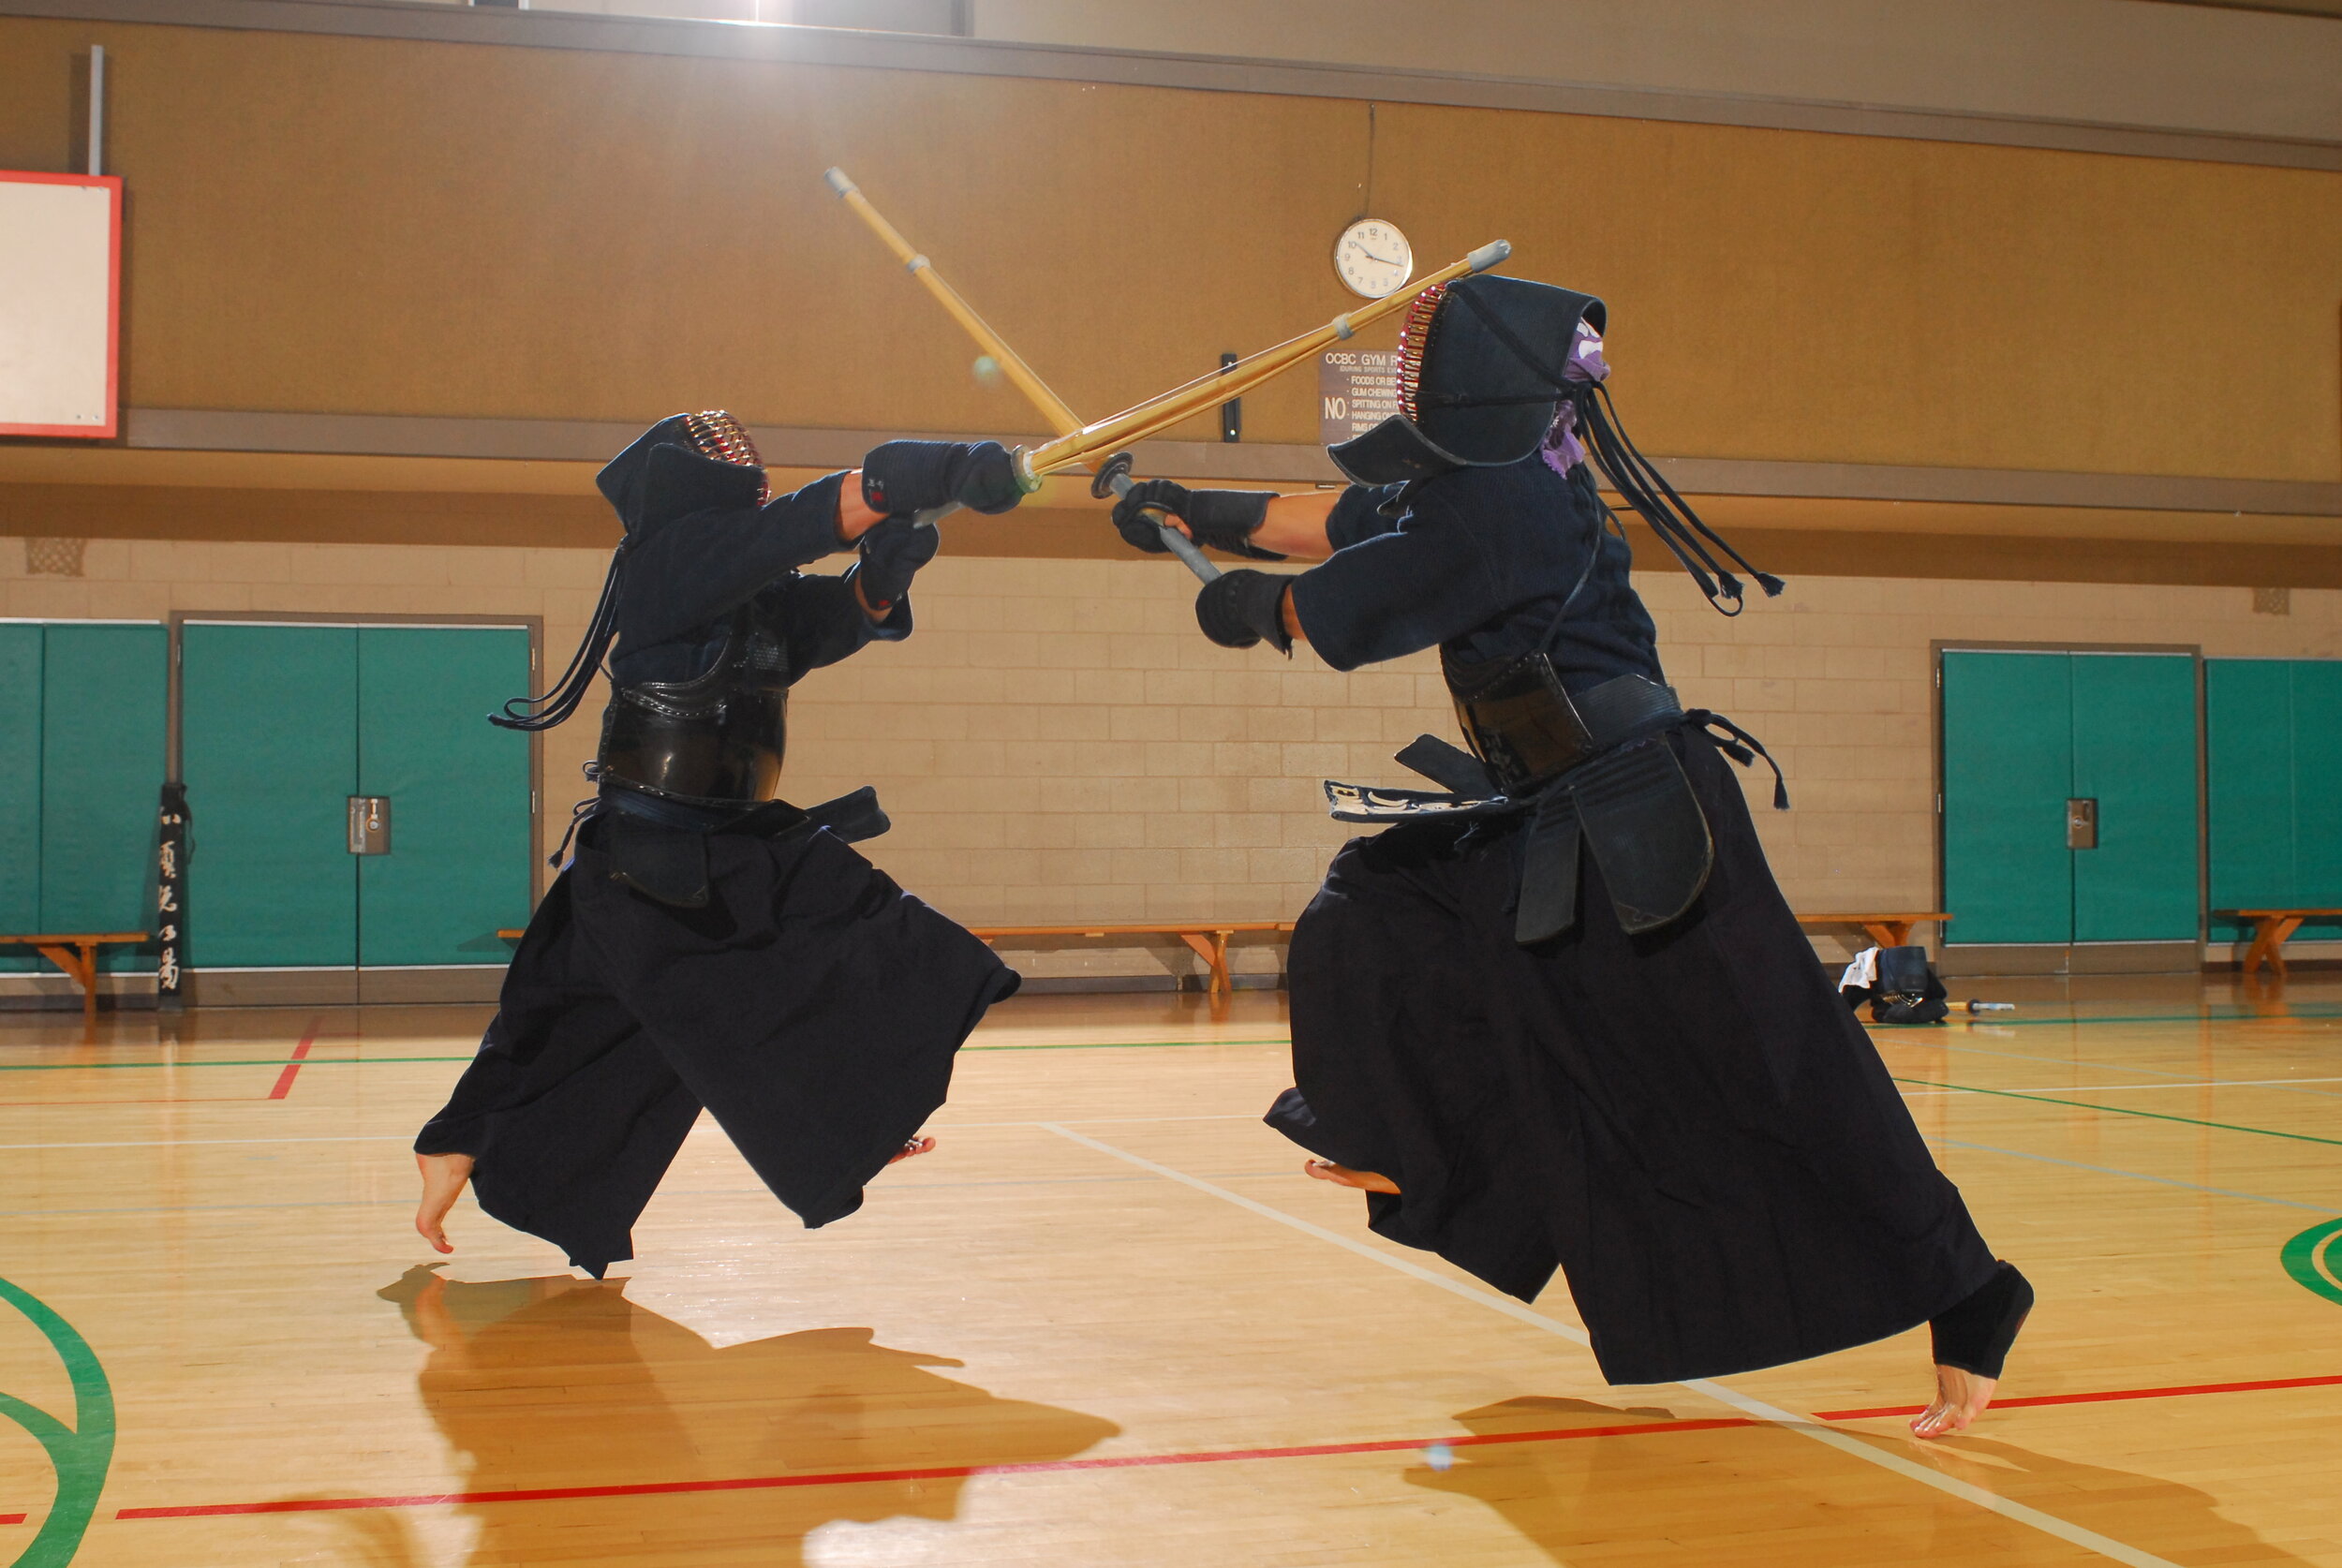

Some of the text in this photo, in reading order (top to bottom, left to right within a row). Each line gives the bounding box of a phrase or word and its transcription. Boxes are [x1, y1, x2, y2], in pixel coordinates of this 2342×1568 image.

[1348, 267, 1355, 275] 8
[1326, 352, 1356, 364] OCBC
[1361, 354, 1386, 366] GYM
[1351, 376, 1374, 385] FOODS
[1375, 377, 1386, 386] OR
[1351, 388, 1398, 397] GUM CHEWING
[1325, 396, 1346, 421] NO
[1352, 399, 1381, 408] SPITTING
[1382, 400, 1392, 409] ON
[1351, 410, 1381, 421] HANGING
[1351, 422, 1368, 432] RIMS
